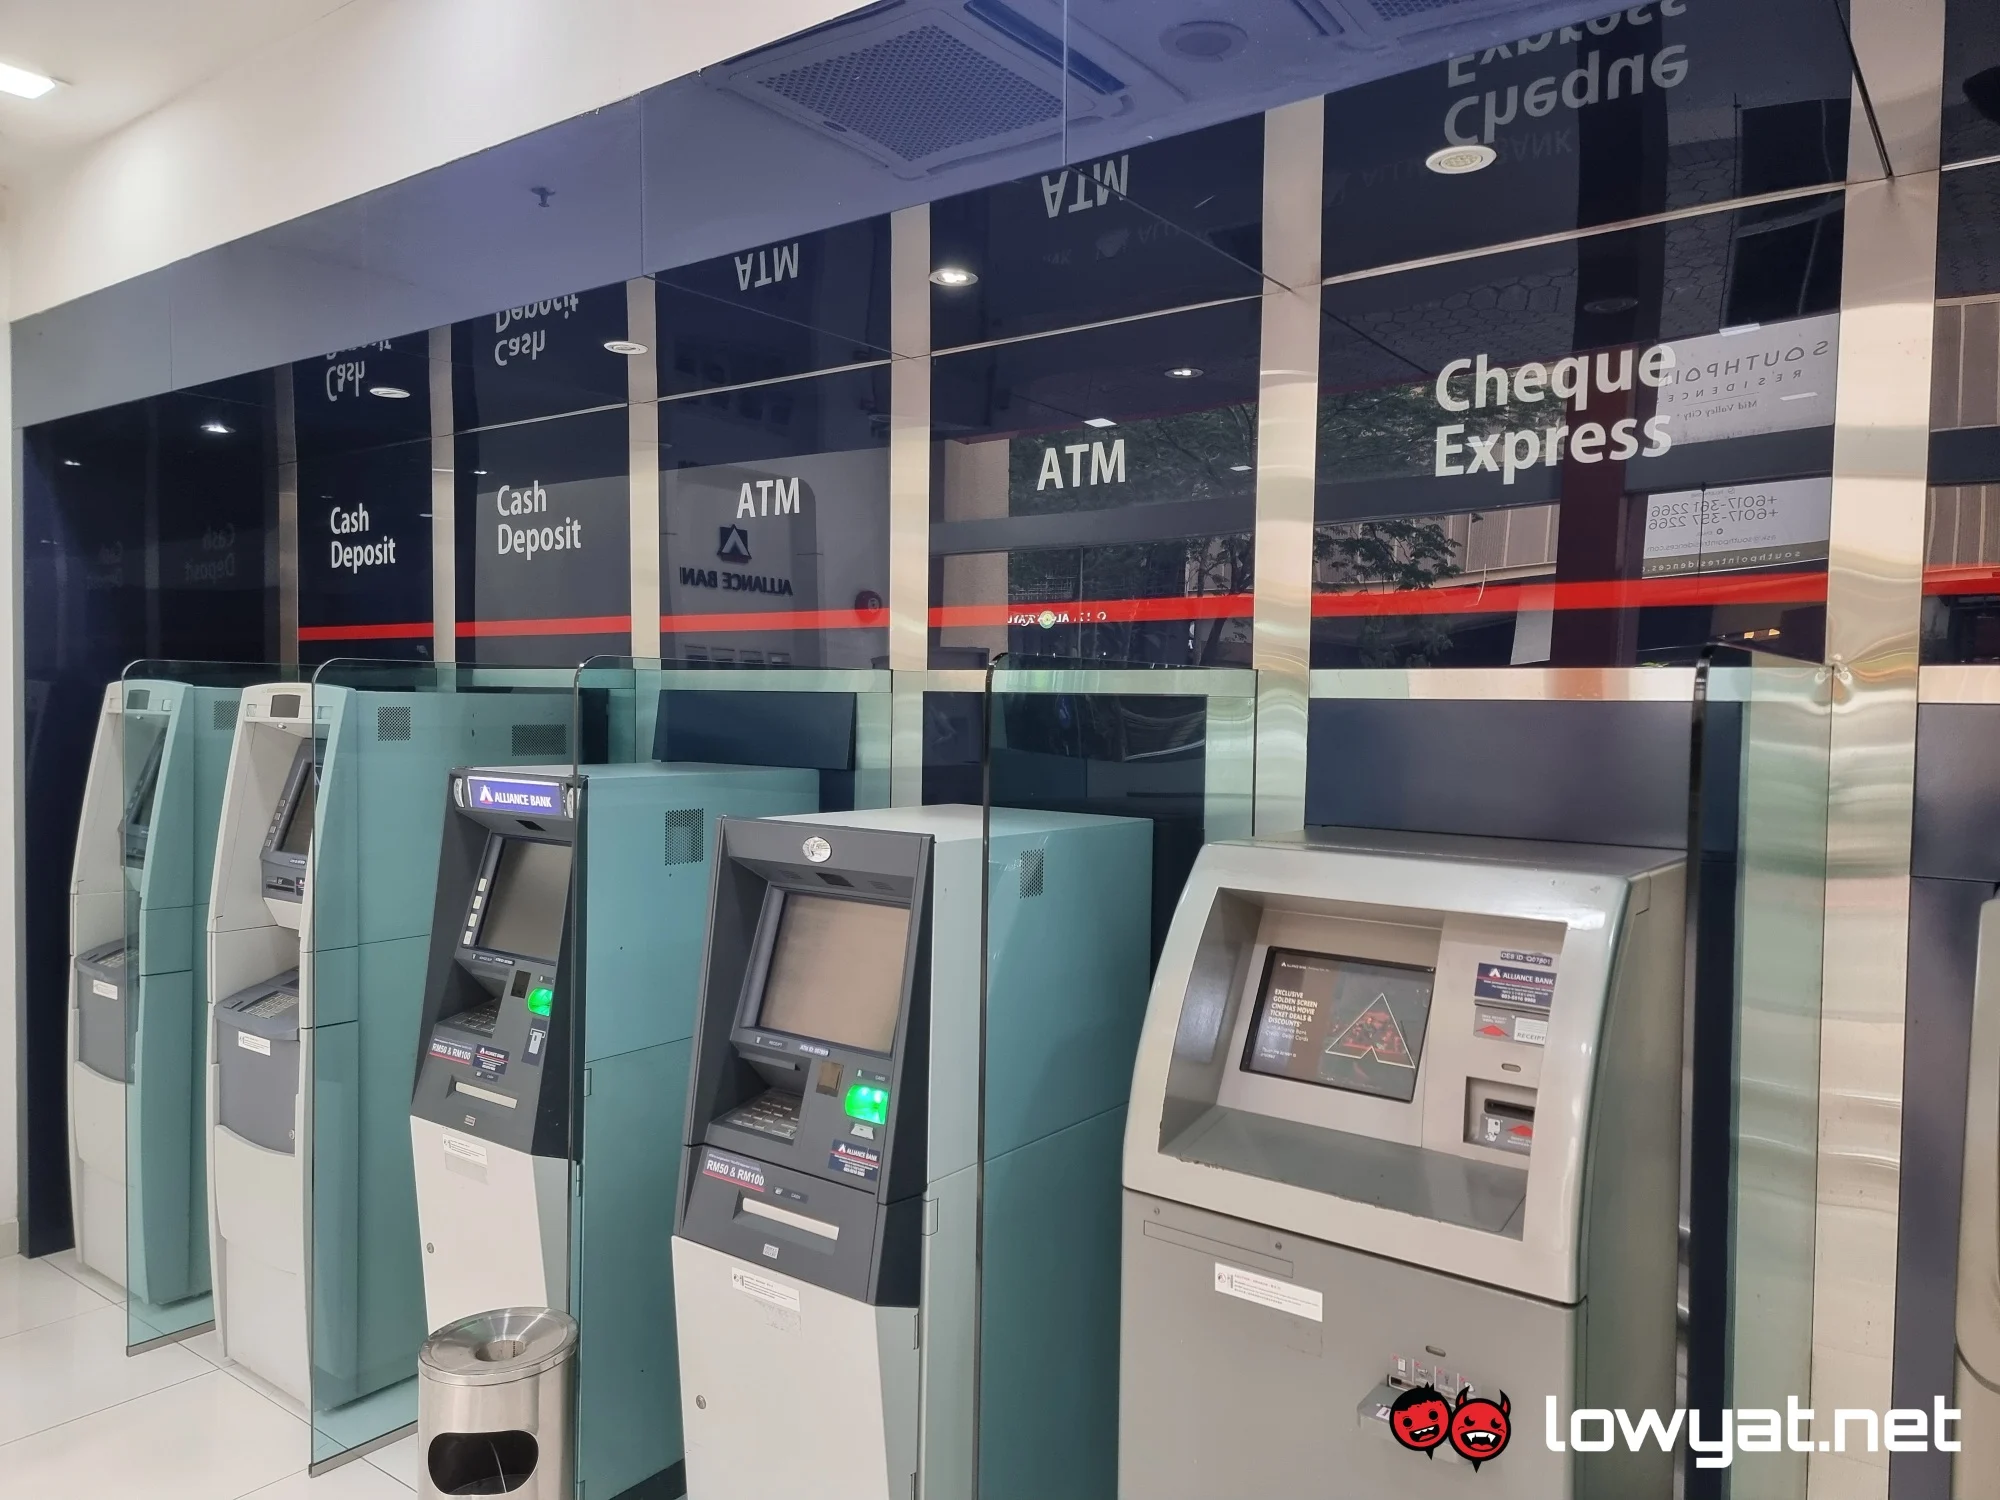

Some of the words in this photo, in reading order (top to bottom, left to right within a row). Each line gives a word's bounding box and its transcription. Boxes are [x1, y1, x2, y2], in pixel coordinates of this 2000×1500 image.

[1435, 343, 1676, 412] Cheque
[1434, 414, 1672, 485] Express
[1036, 438, 1126, 491] ATM
[497, 480, 547, 517] Cash
[736, 477, 800, 519] ATM
[330, 503, 370, 535] Cash
[497, 517, 582, 561] Deposit
[331, 536, 396, 575] Deposit
[494, 791, 530, 806] ALLIANCE
[530, 794, 552, 808] BANK
[1274, 988, 1304, 999] EXCLUSIVE
[1502, 972, 1533, 983] ALLIANCE
[1534, 976, 1554, 986] BANK
[1270, 1009, 1289, 1018] TICKET
[1289, 1013, 1307, 1022] DEALS
[1271, 1003, 1296, 1012] CINEMAS
[1297, 1006, 1316, 1015] MOVIE
[1272, 996, 1297, 1005] GOLDEN
[1297, 1000, 1318, 1009] SCREEN
[1516, 1032, 1545, 1042] RECEIPT
[706, 1159, 729, 1175] RM50
[729, 1166, 736, 1177] &
[737, 1169, 765, 1186] RM100
